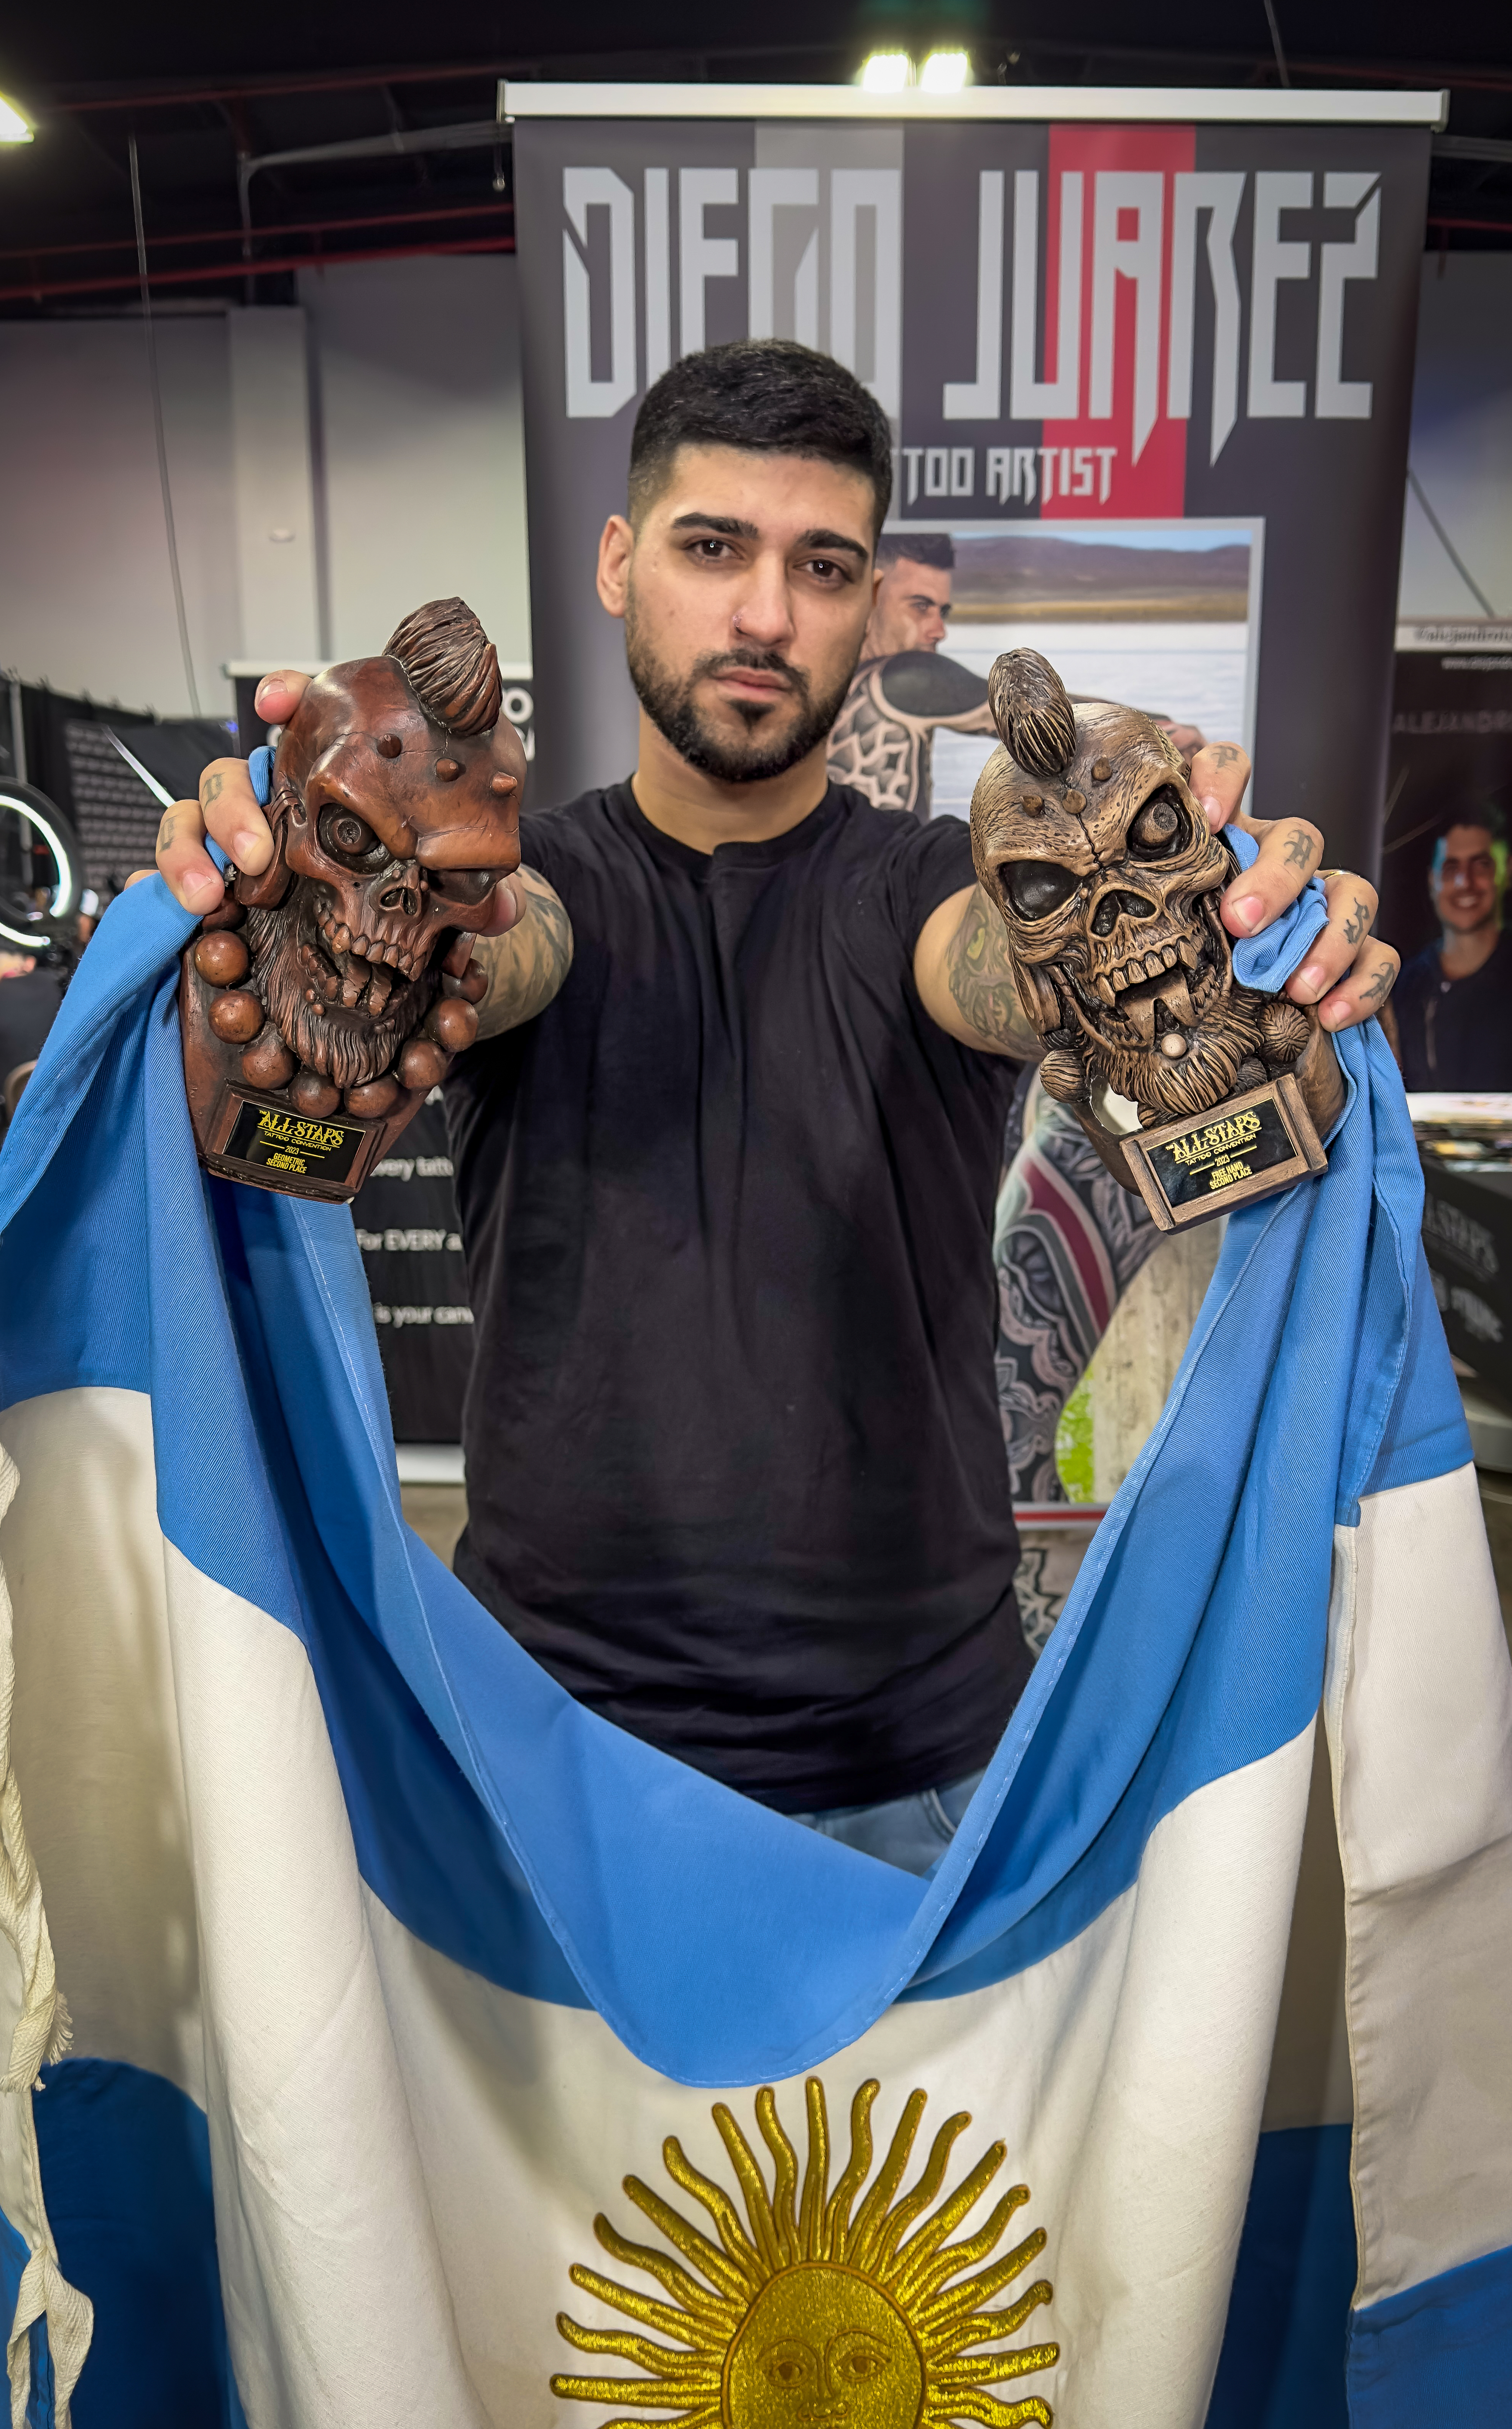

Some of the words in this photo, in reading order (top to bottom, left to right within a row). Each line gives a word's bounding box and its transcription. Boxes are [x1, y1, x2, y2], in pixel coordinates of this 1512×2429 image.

[943, 170, 1381, 467] JUAREZ
[890, 447, 974, 506] TOO
[985, 447, 1118, 506] ARTIST
[258, 1111, 344, 1147] ALL-STARS
[1173, 1111, 1261, 1161] ALL-STARS
[264, 1131, 289, 1141] TATTOO
[291, 1139, 332, 1151] CONVENTION
[285, 1145, 299, 1155] 2023
[1185, 1152, 1211, 1166] TATTOO
[1213, 1133, 1256, 1154] CONVENTION
[266, 1158, 289, 1169] SECOND
[289, 1164, 307, 1173] PLACE
[273, 1152, 305, 1166] GEOMETRIC
[1215, 1154, 1230, 1167] 2023
[1209, 1174, 1234, 1190] SECOND
[1233, 1166, 1252, 1180] PLACE
[1211, 1168, 1226, 1180] FREE
[1226, 1161, 1244, 1173] HAND
[384, 1228, 447, 1251] EVERY
[392, 1306, 434, 1328] your
